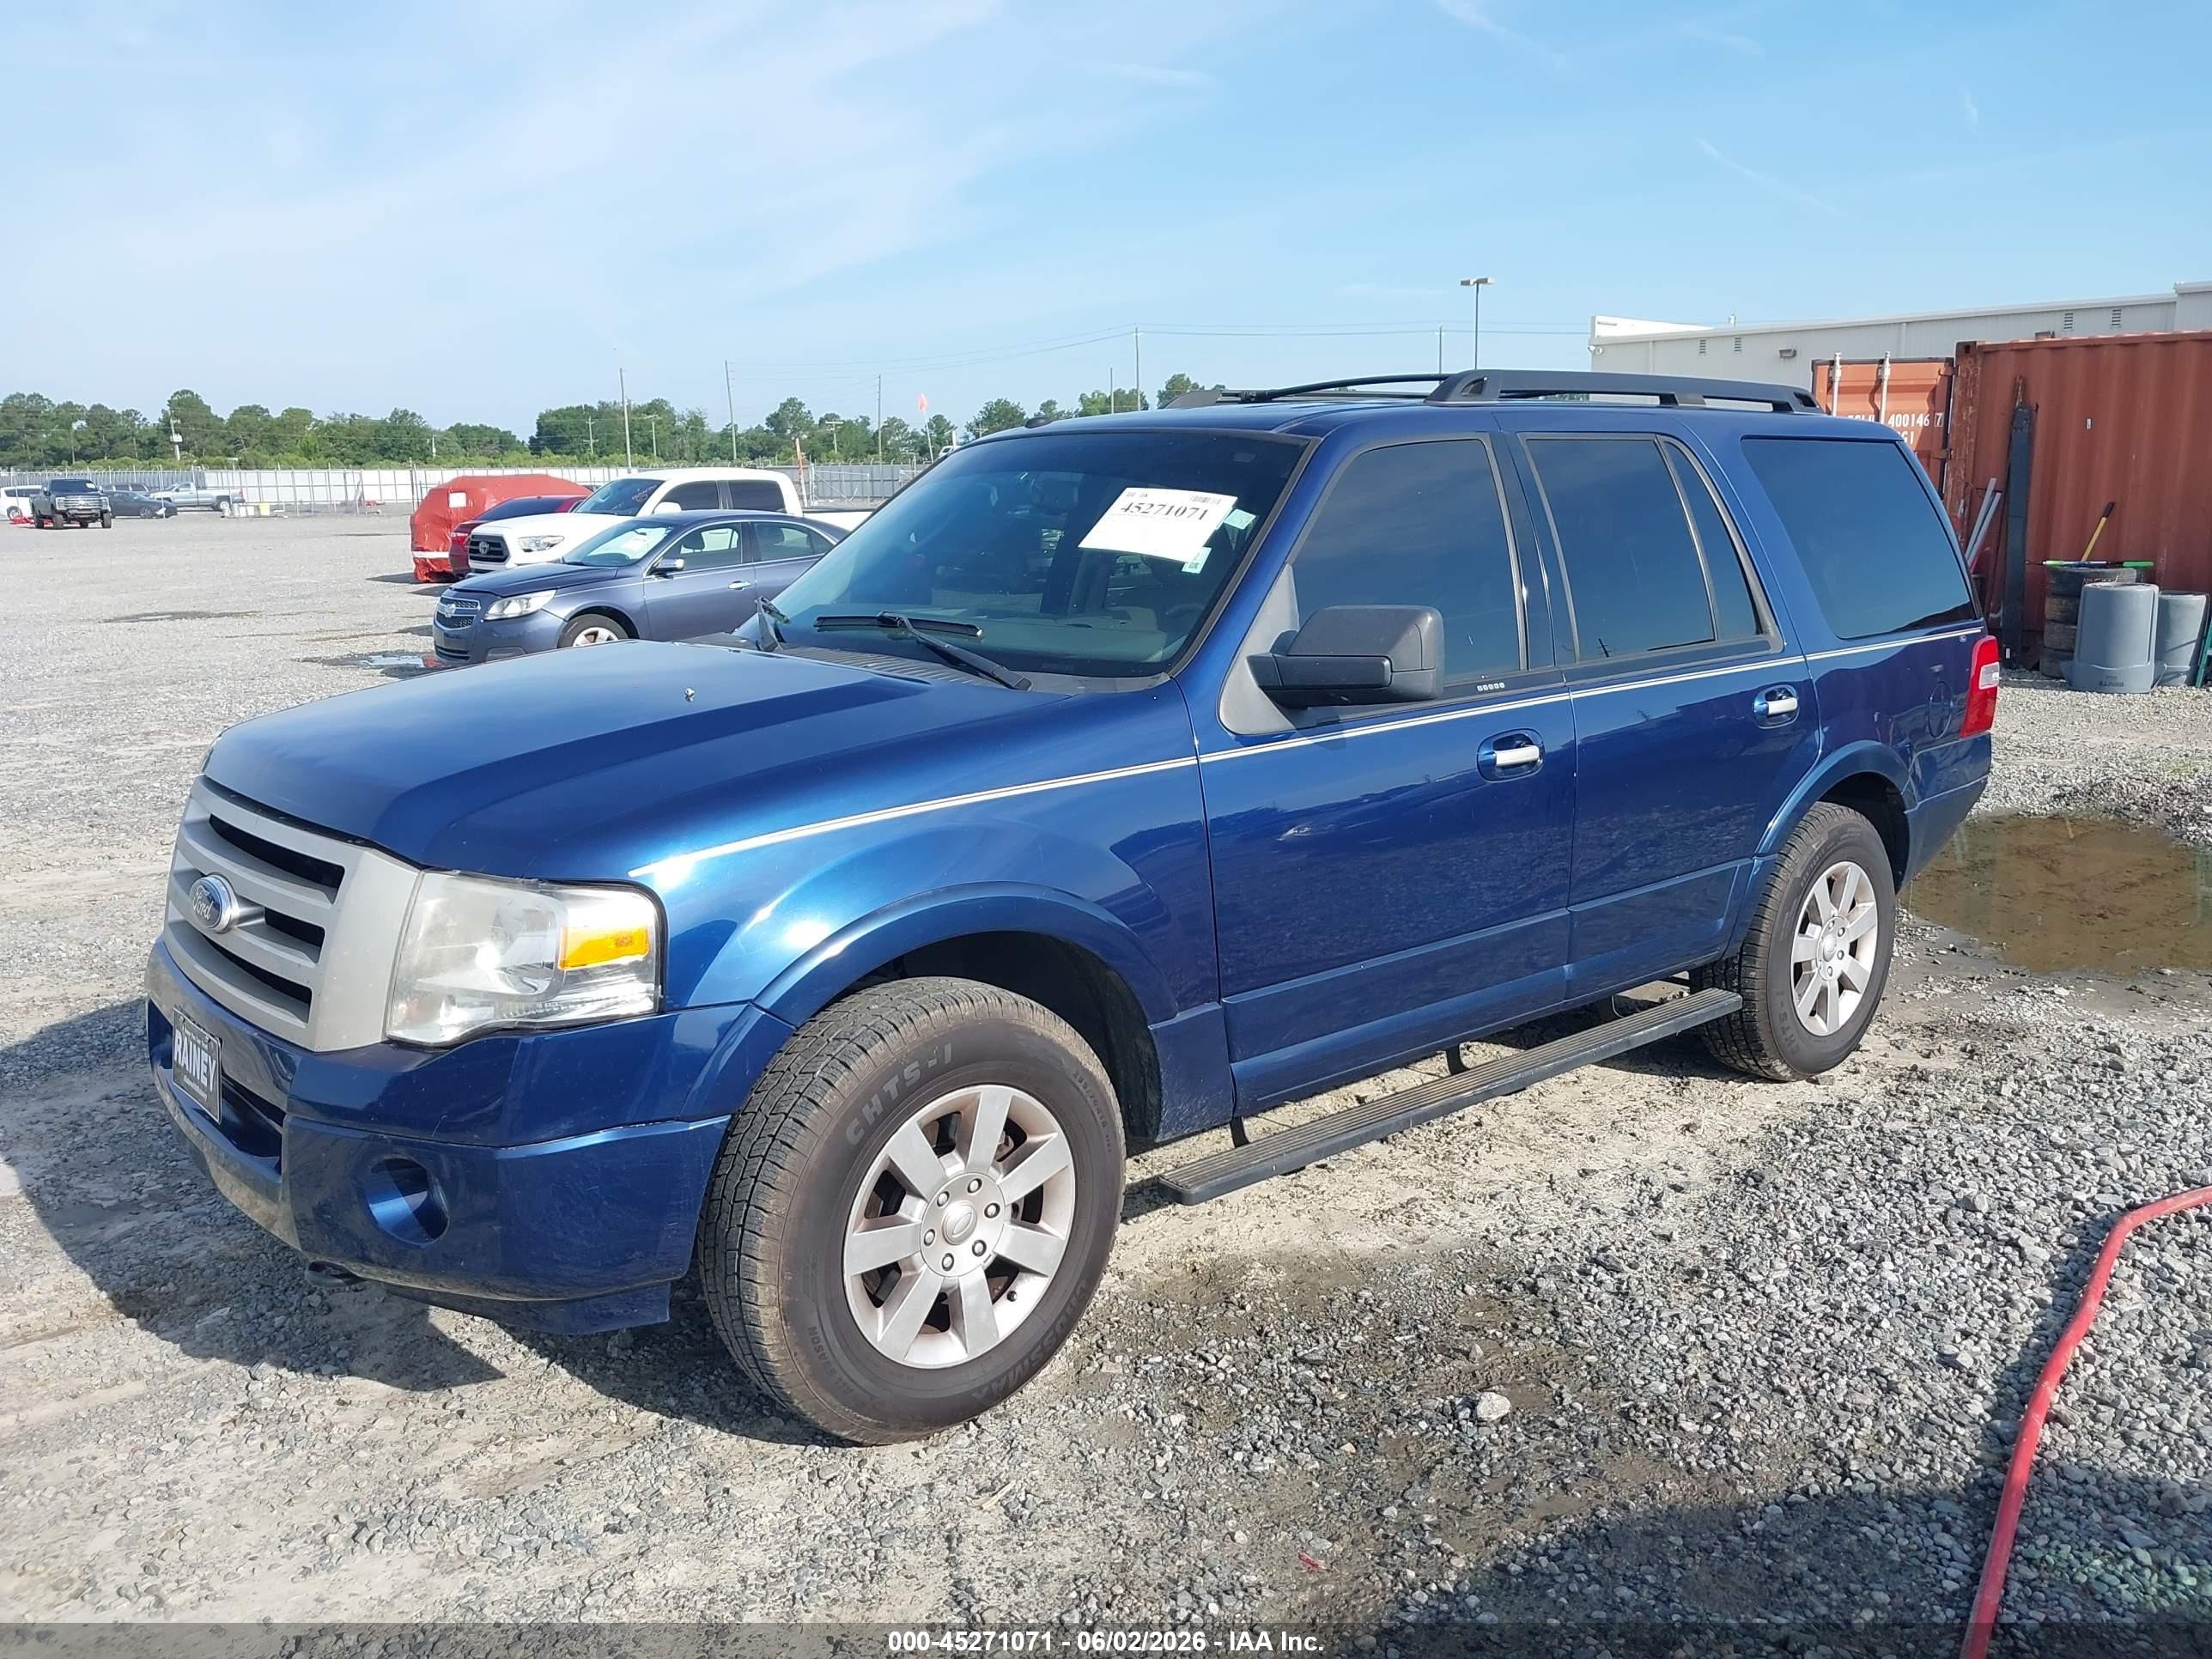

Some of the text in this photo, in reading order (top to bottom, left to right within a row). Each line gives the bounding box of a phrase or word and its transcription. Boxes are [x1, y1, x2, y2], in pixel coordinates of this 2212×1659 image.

[1888, 413, 1929, 428] 400146
[1120, 501, 1208, 520] 45271071
[192, 885, 214, 921] Ford
[174, 1029, 216, 1093] RAINEY
